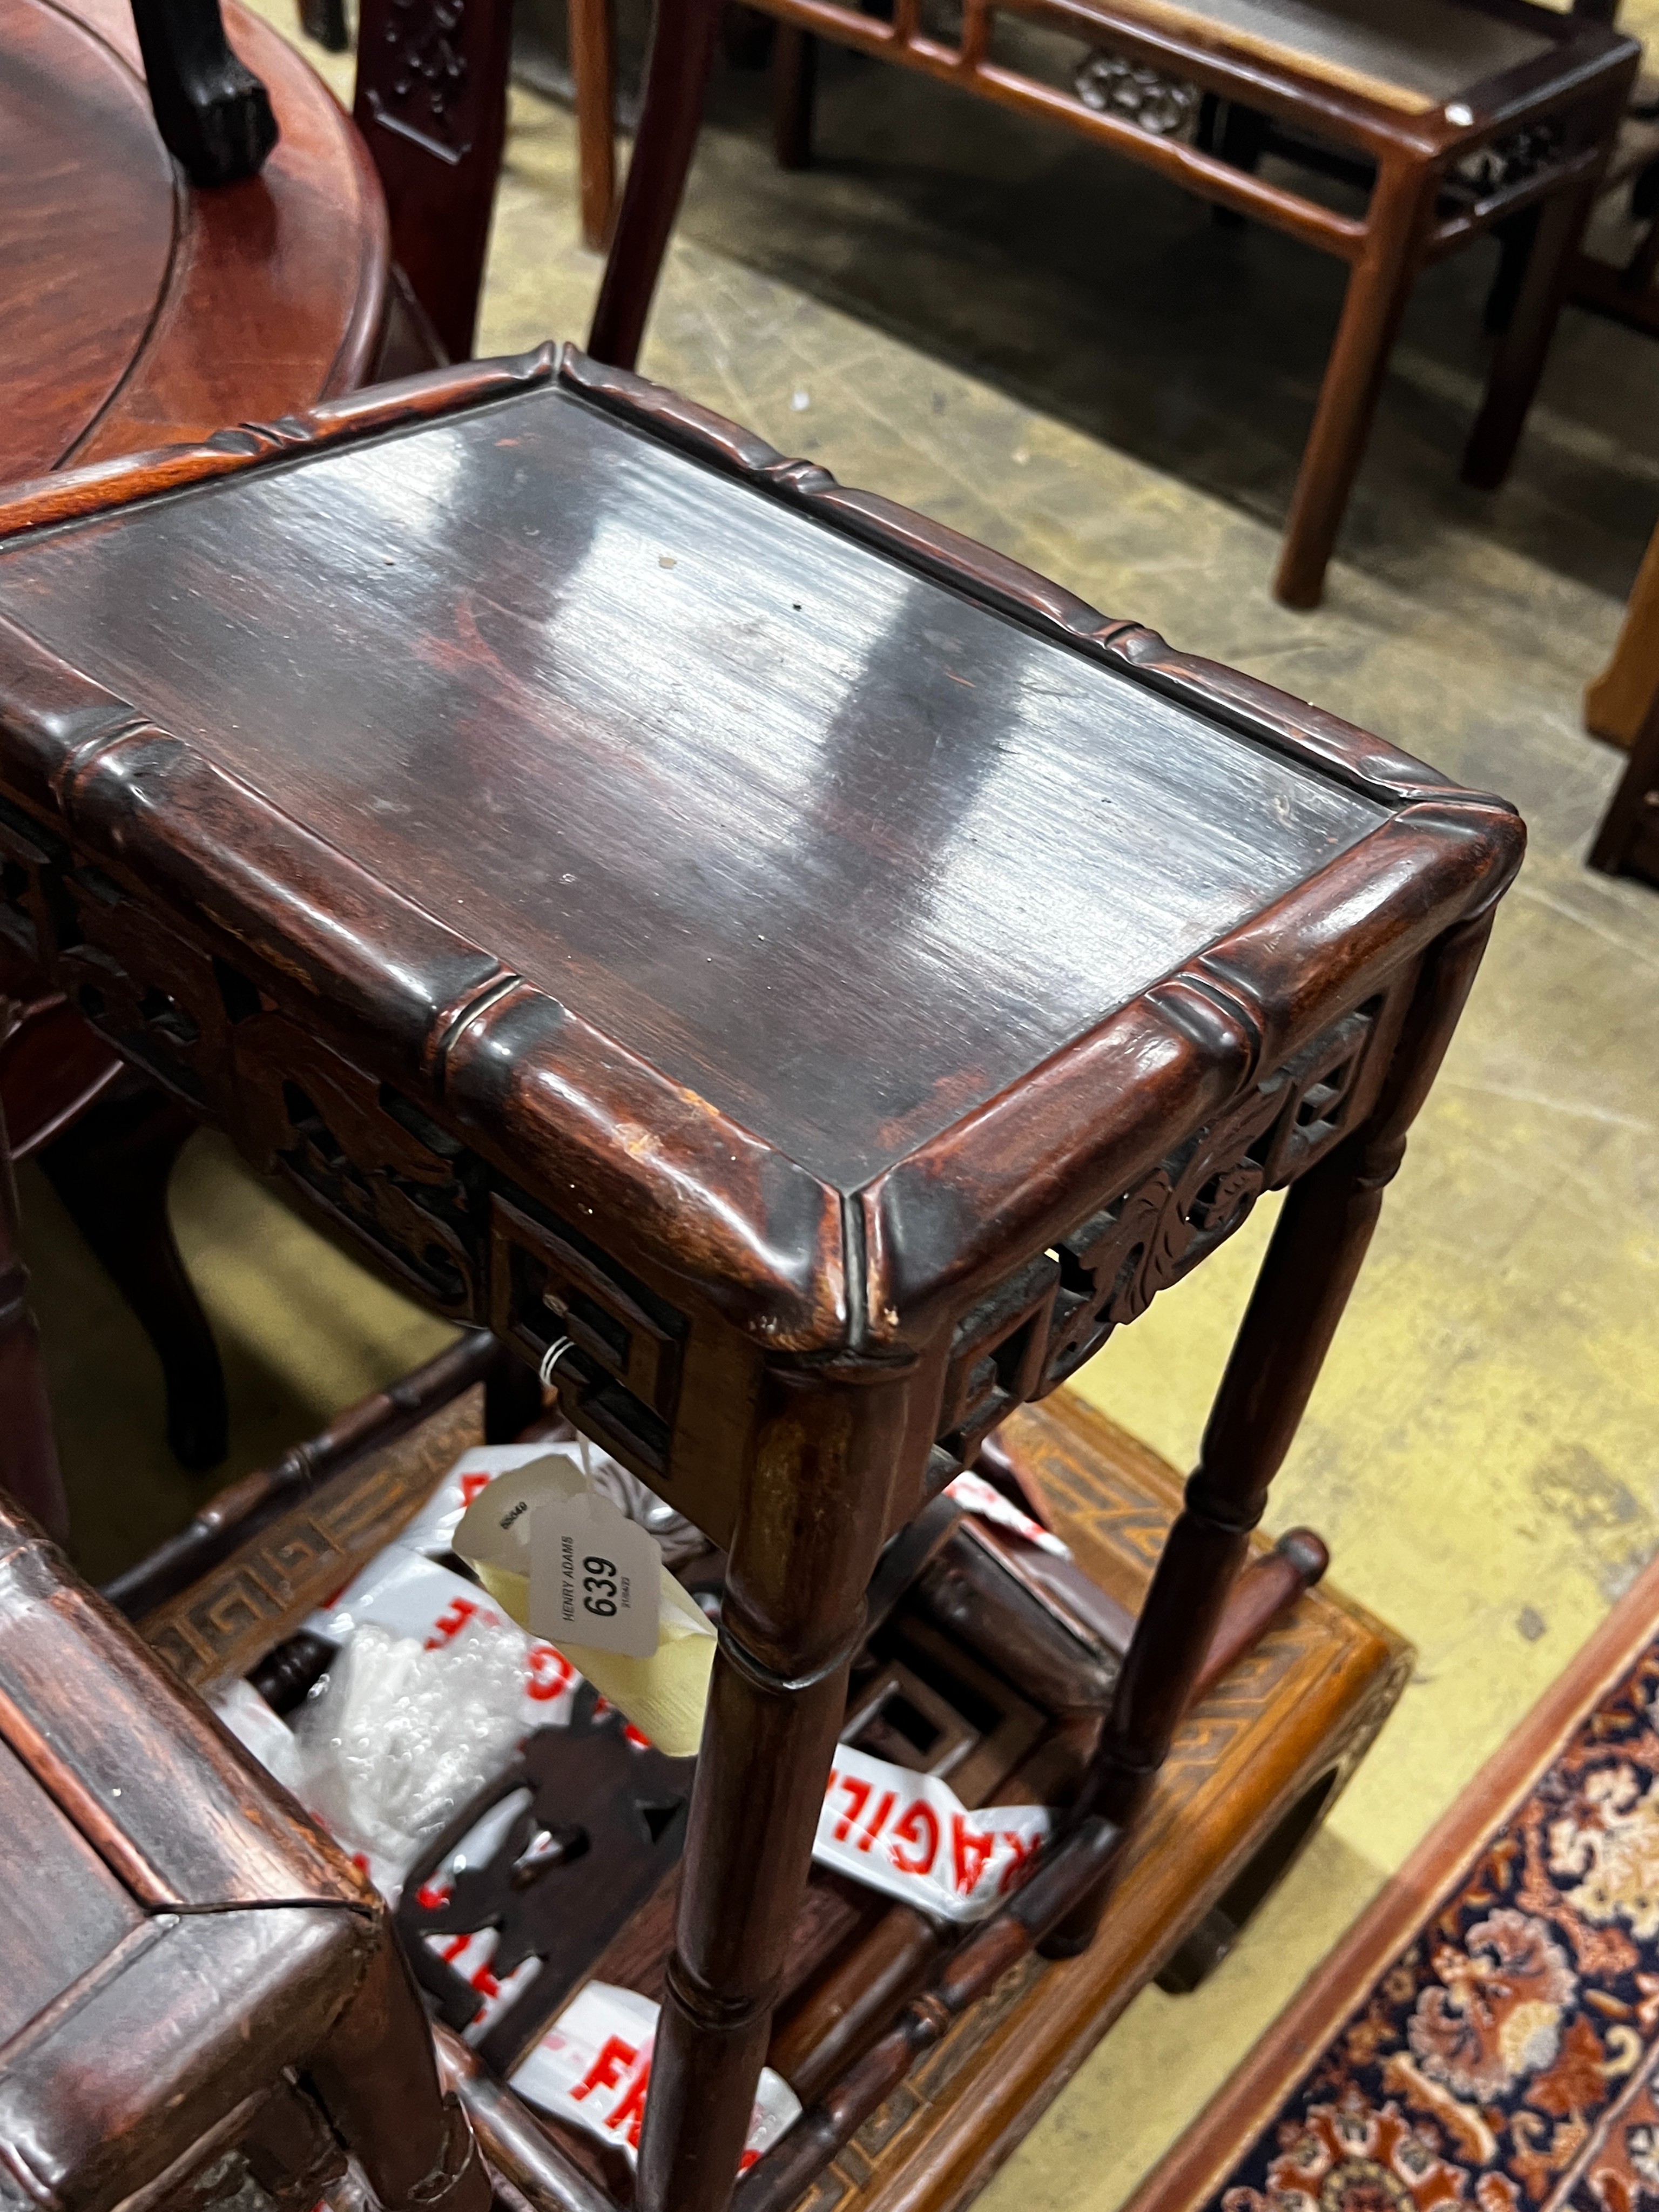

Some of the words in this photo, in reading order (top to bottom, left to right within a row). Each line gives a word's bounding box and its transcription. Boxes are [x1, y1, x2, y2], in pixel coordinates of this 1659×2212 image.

[561, 1535, 574, 1579] ADAMS
[562, 1580, 575, 1622] HENRY
[583, 1556, 617, 1617] 639
